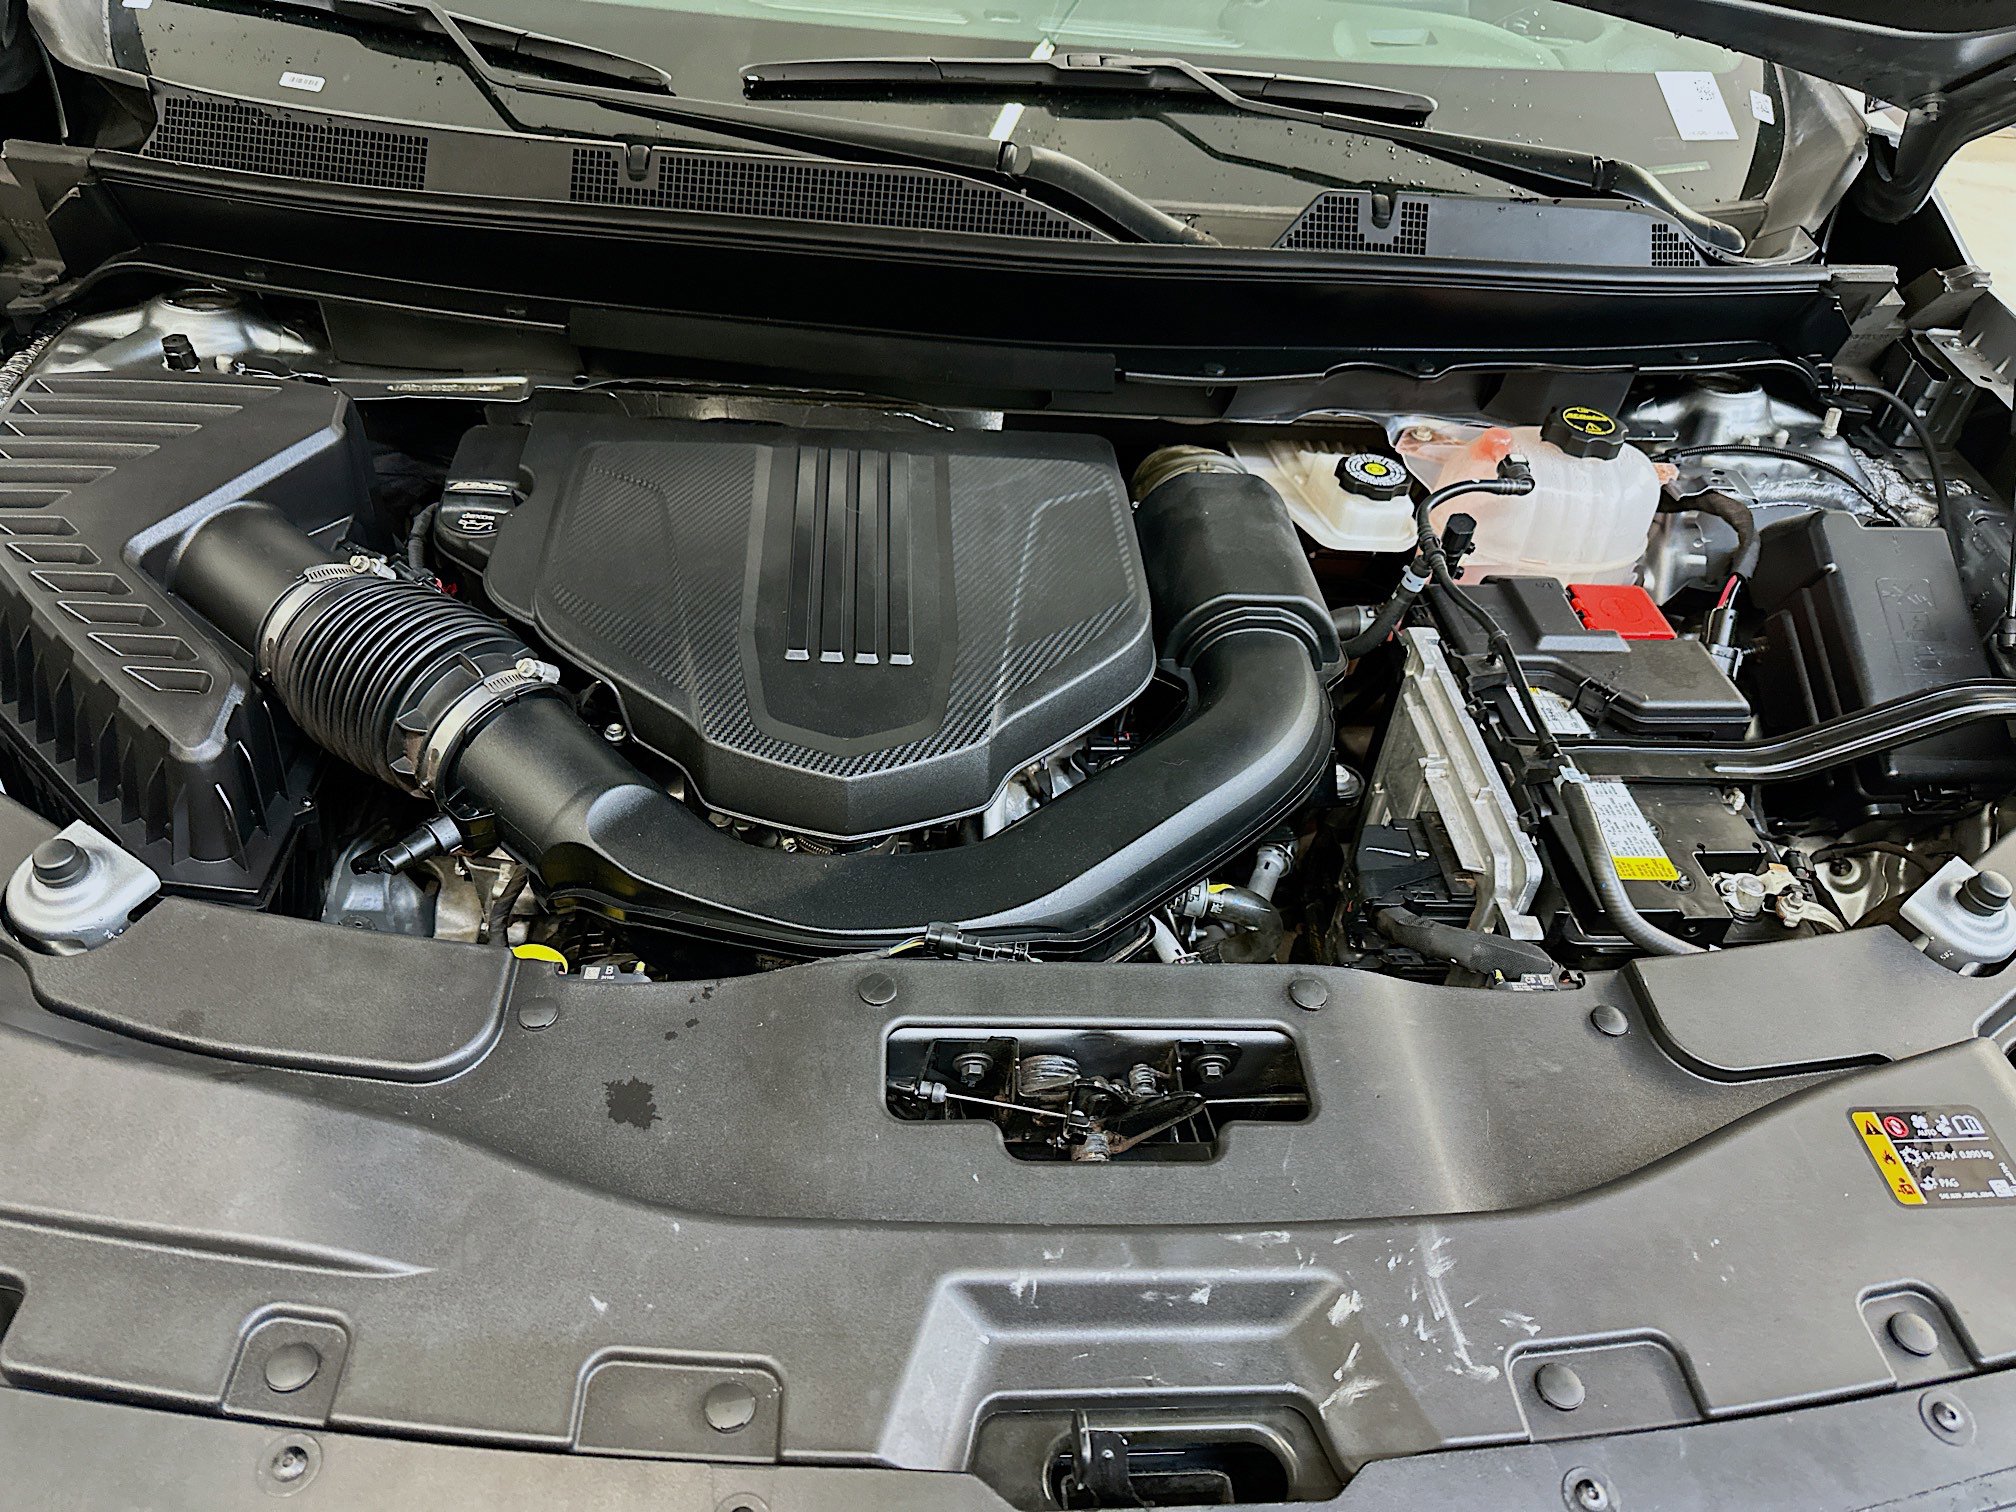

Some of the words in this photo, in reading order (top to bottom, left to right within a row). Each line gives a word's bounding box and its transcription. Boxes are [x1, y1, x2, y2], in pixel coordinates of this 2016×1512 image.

[605, 965, 614, 975] B
[1917, 1129, 1938, 1137] AUTO
[1938, 1177, 1960, 1188] PAG
